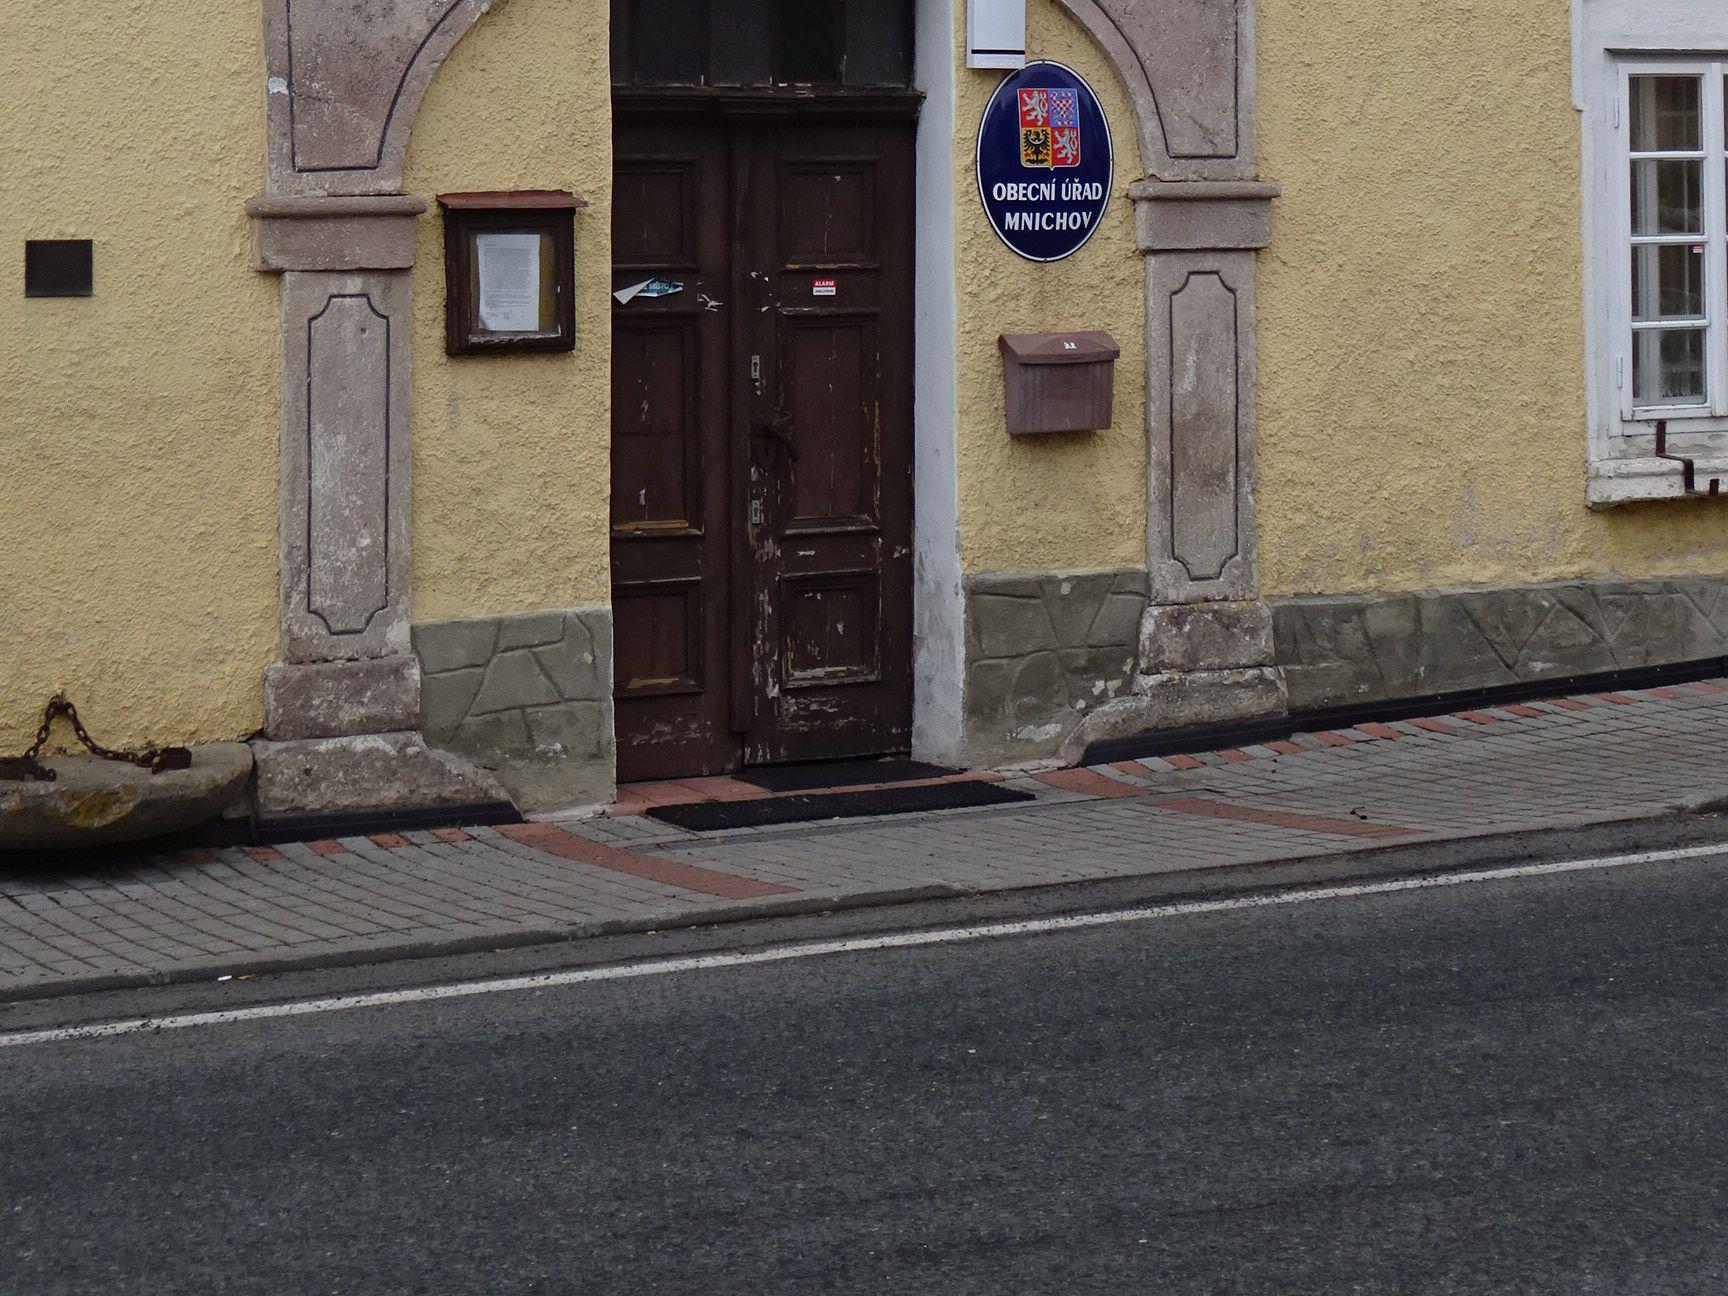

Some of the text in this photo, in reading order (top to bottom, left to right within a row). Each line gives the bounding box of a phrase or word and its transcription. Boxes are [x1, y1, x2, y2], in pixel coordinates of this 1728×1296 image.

[992, 177, 1103, 202] OBECNÍ ÚŘAD
[1004, 211, 1094, 231] MNICHOV
